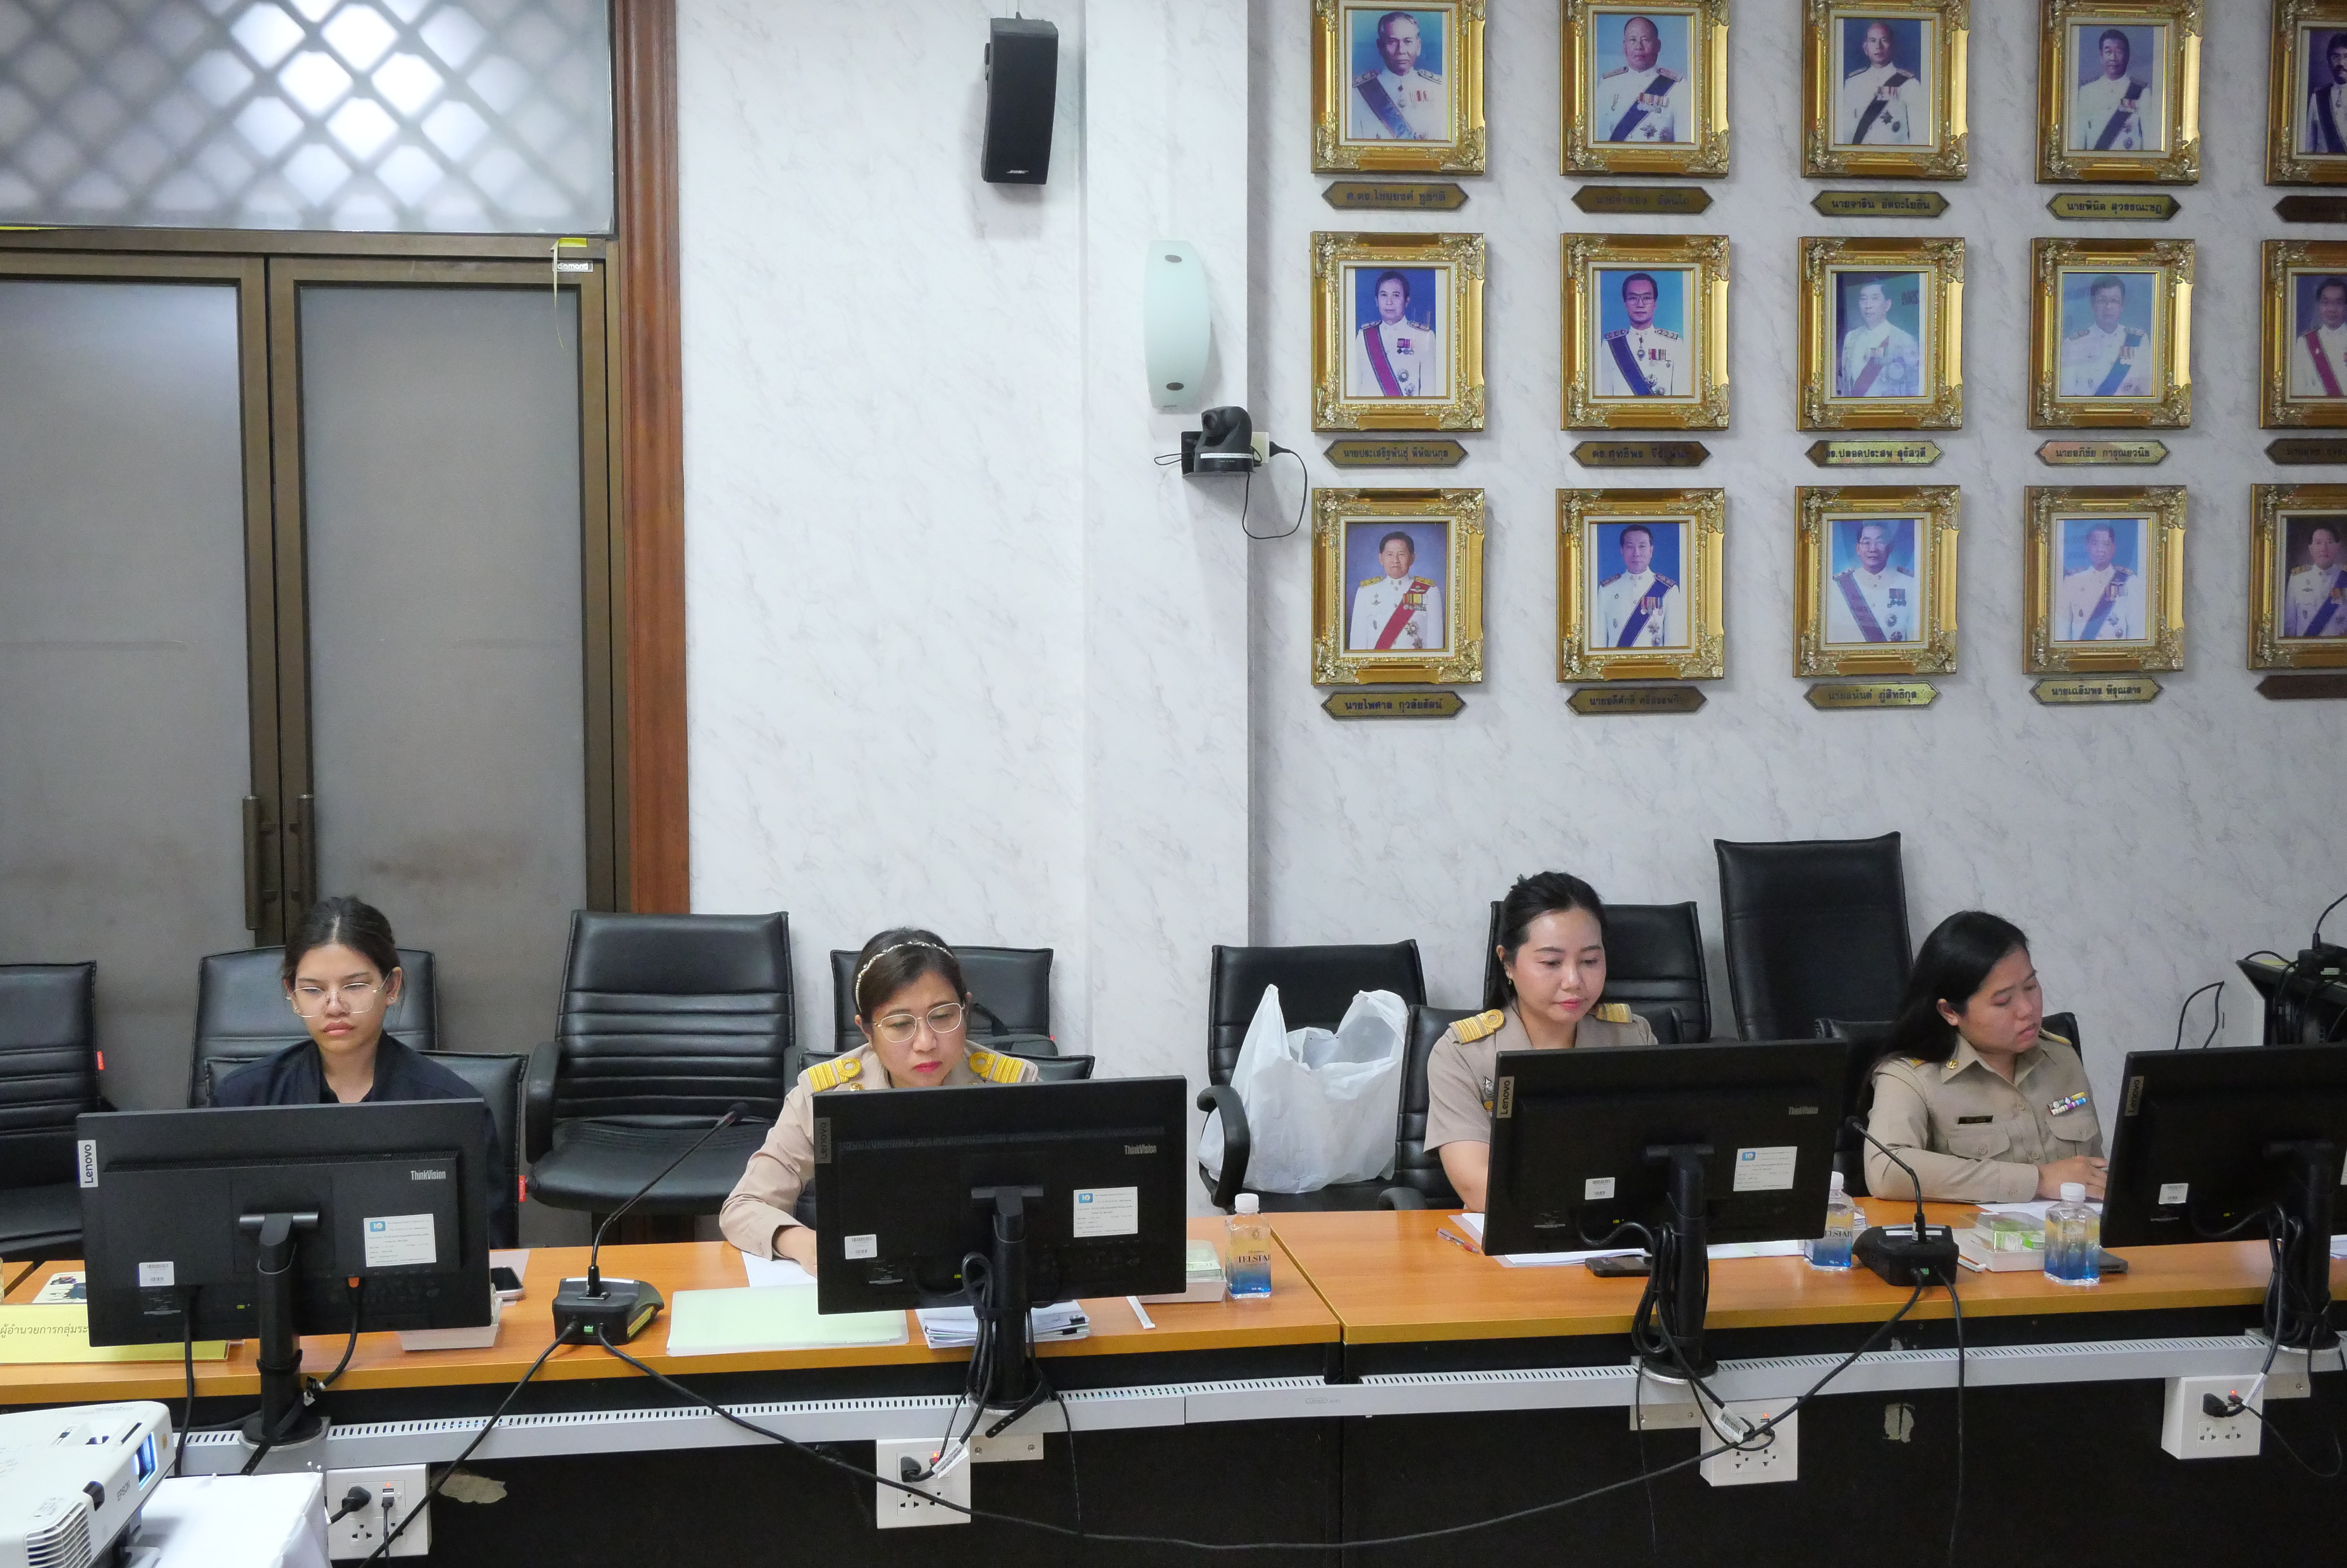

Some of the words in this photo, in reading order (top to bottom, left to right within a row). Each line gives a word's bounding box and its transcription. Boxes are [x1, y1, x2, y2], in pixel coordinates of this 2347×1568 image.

[1500, 1080, 1510, 1115] Lenovo
[819, 1122, 828, 1161] Lenovo
[1124, 1144, 1157, 1155] ThinkVision
[84, 1144, 94, 1184] Lenovo
[410, 1169, 446, 1180] ThinkVision
[0, 1323, 88, 1338] ผู้อำนวยการกลุ่มระ
[117, 1479, 130, 1502] EPSON
